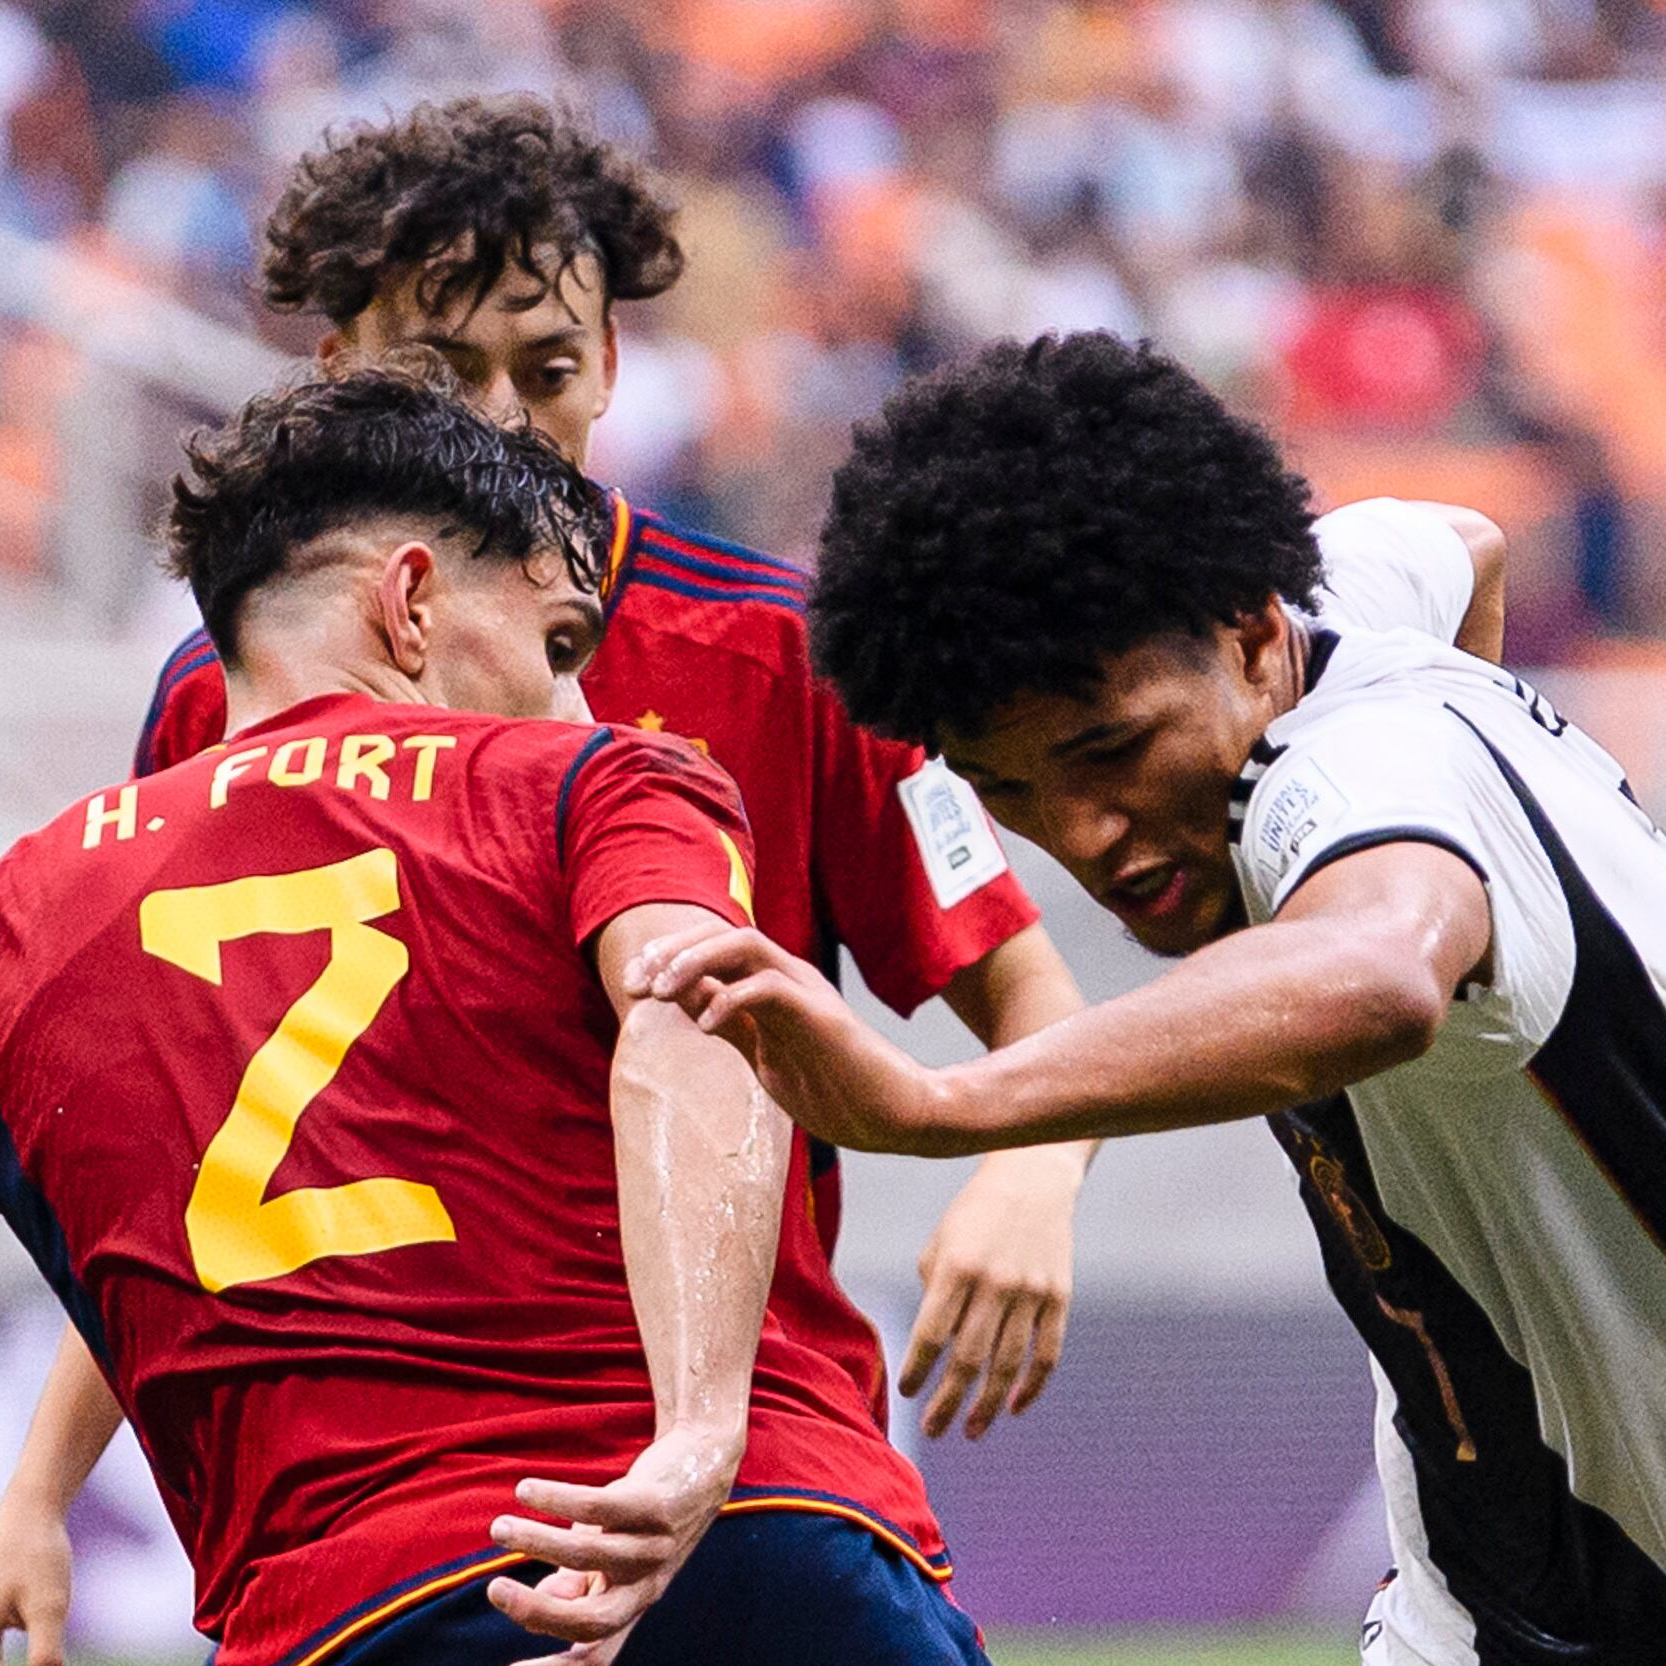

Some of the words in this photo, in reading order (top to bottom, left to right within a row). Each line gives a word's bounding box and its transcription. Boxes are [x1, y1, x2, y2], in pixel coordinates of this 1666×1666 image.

[81, 784, 166, 850] H.
[208, 733, 458, 811] FORT
[139, 847, 458, 1295] 2
